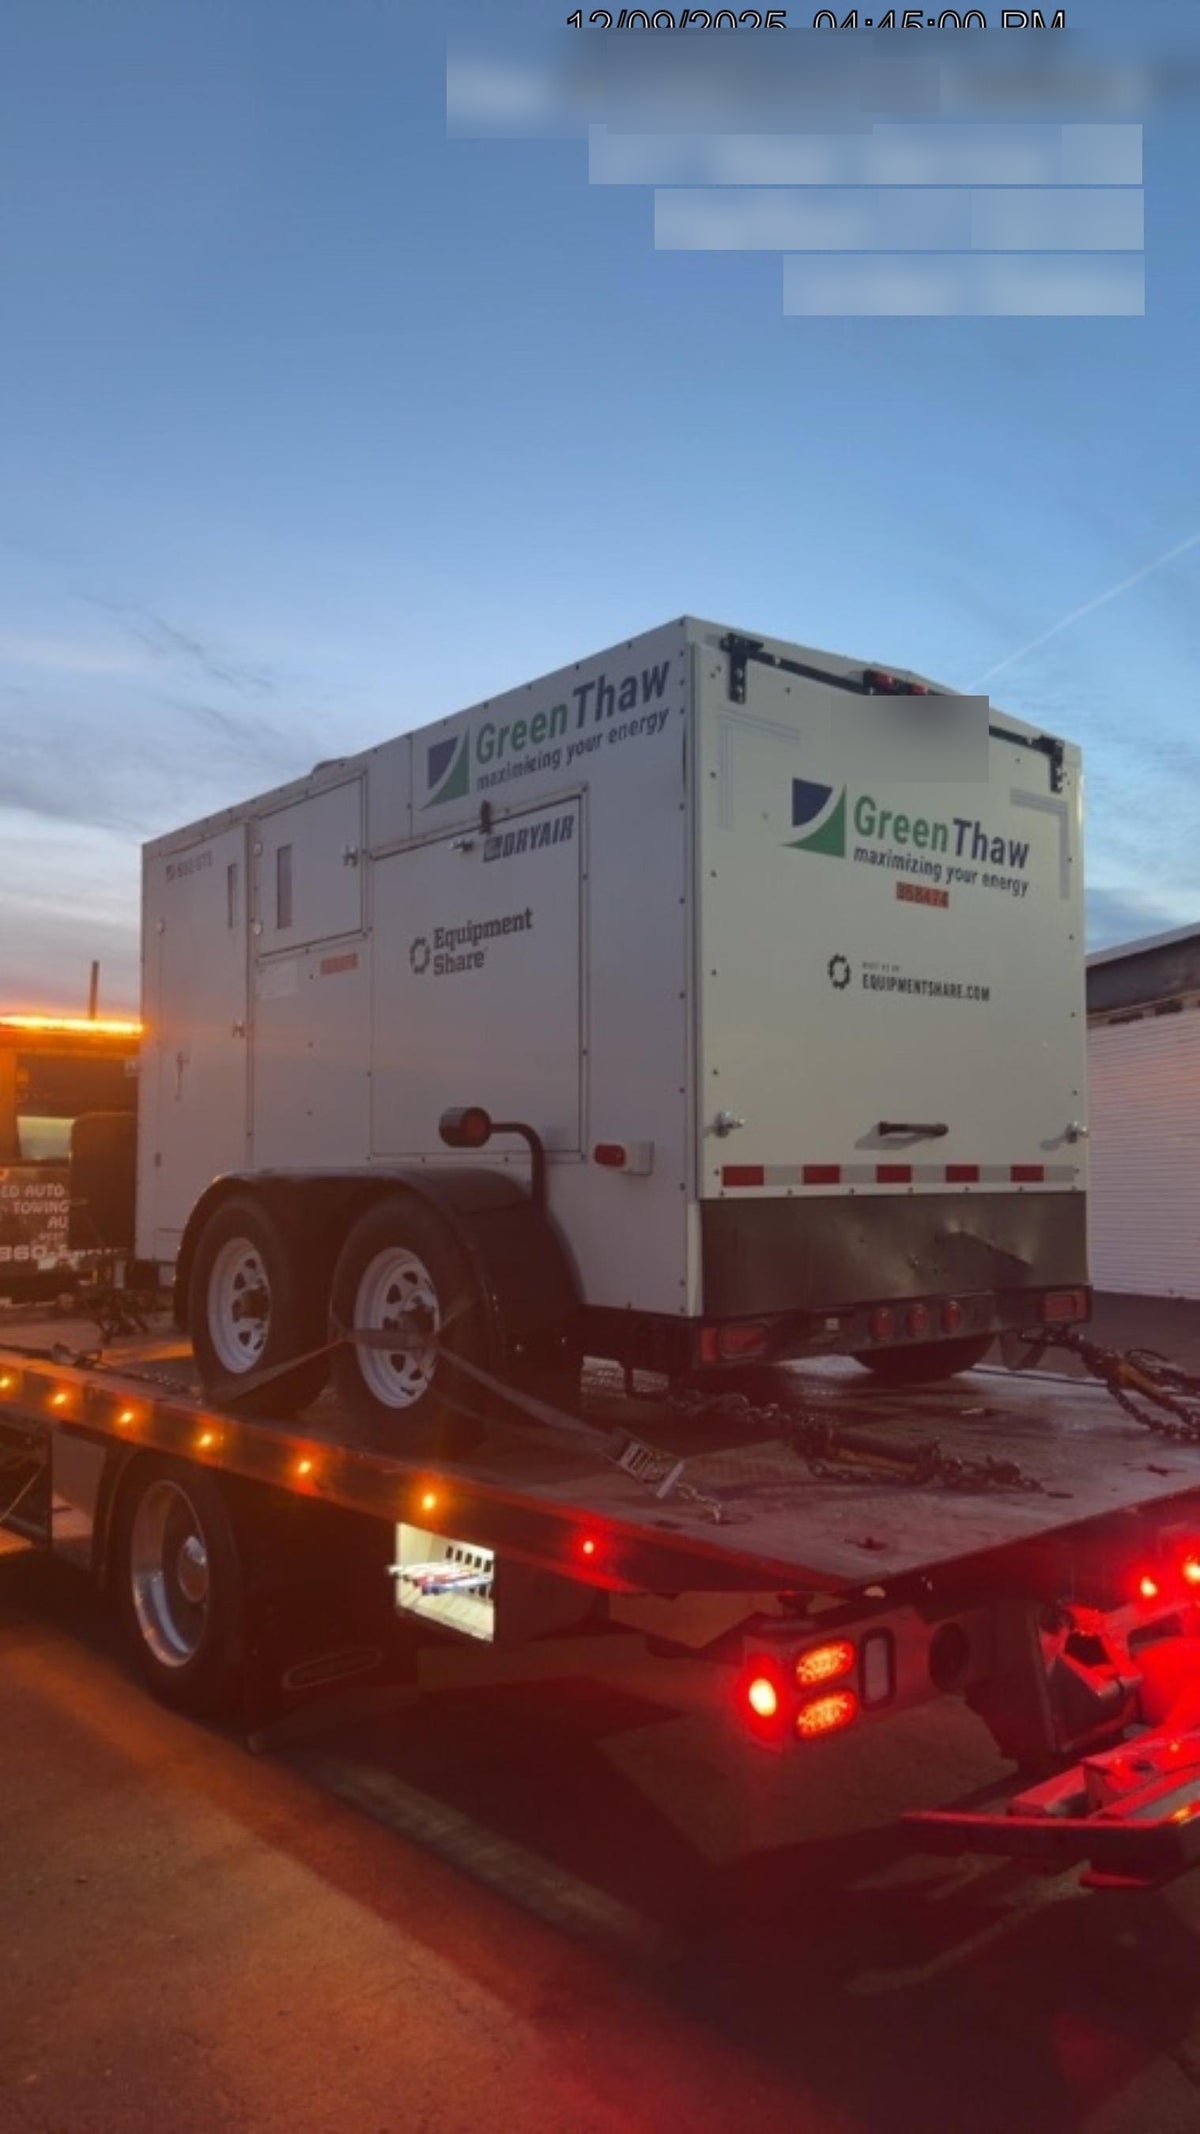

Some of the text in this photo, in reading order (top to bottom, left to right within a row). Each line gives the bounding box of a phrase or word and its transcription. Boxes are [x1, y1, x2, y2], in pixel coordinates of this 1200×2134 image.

[566, 732, 603, 765] your
[608, 708, 670, 744] energy
[502, 815, 575, 857] DRYAIR
[854, 846, 1029, 897] maximizing your energy
[433, 907, 533, 950] Equipment
[433, 950, 485, 975] Share
[862, 973, 991, 1001] EQUIPMENTSHARE.COM
[13, 1199, 70, 1215] TOWING
[24, 1183, 65, 1198] AUTO
